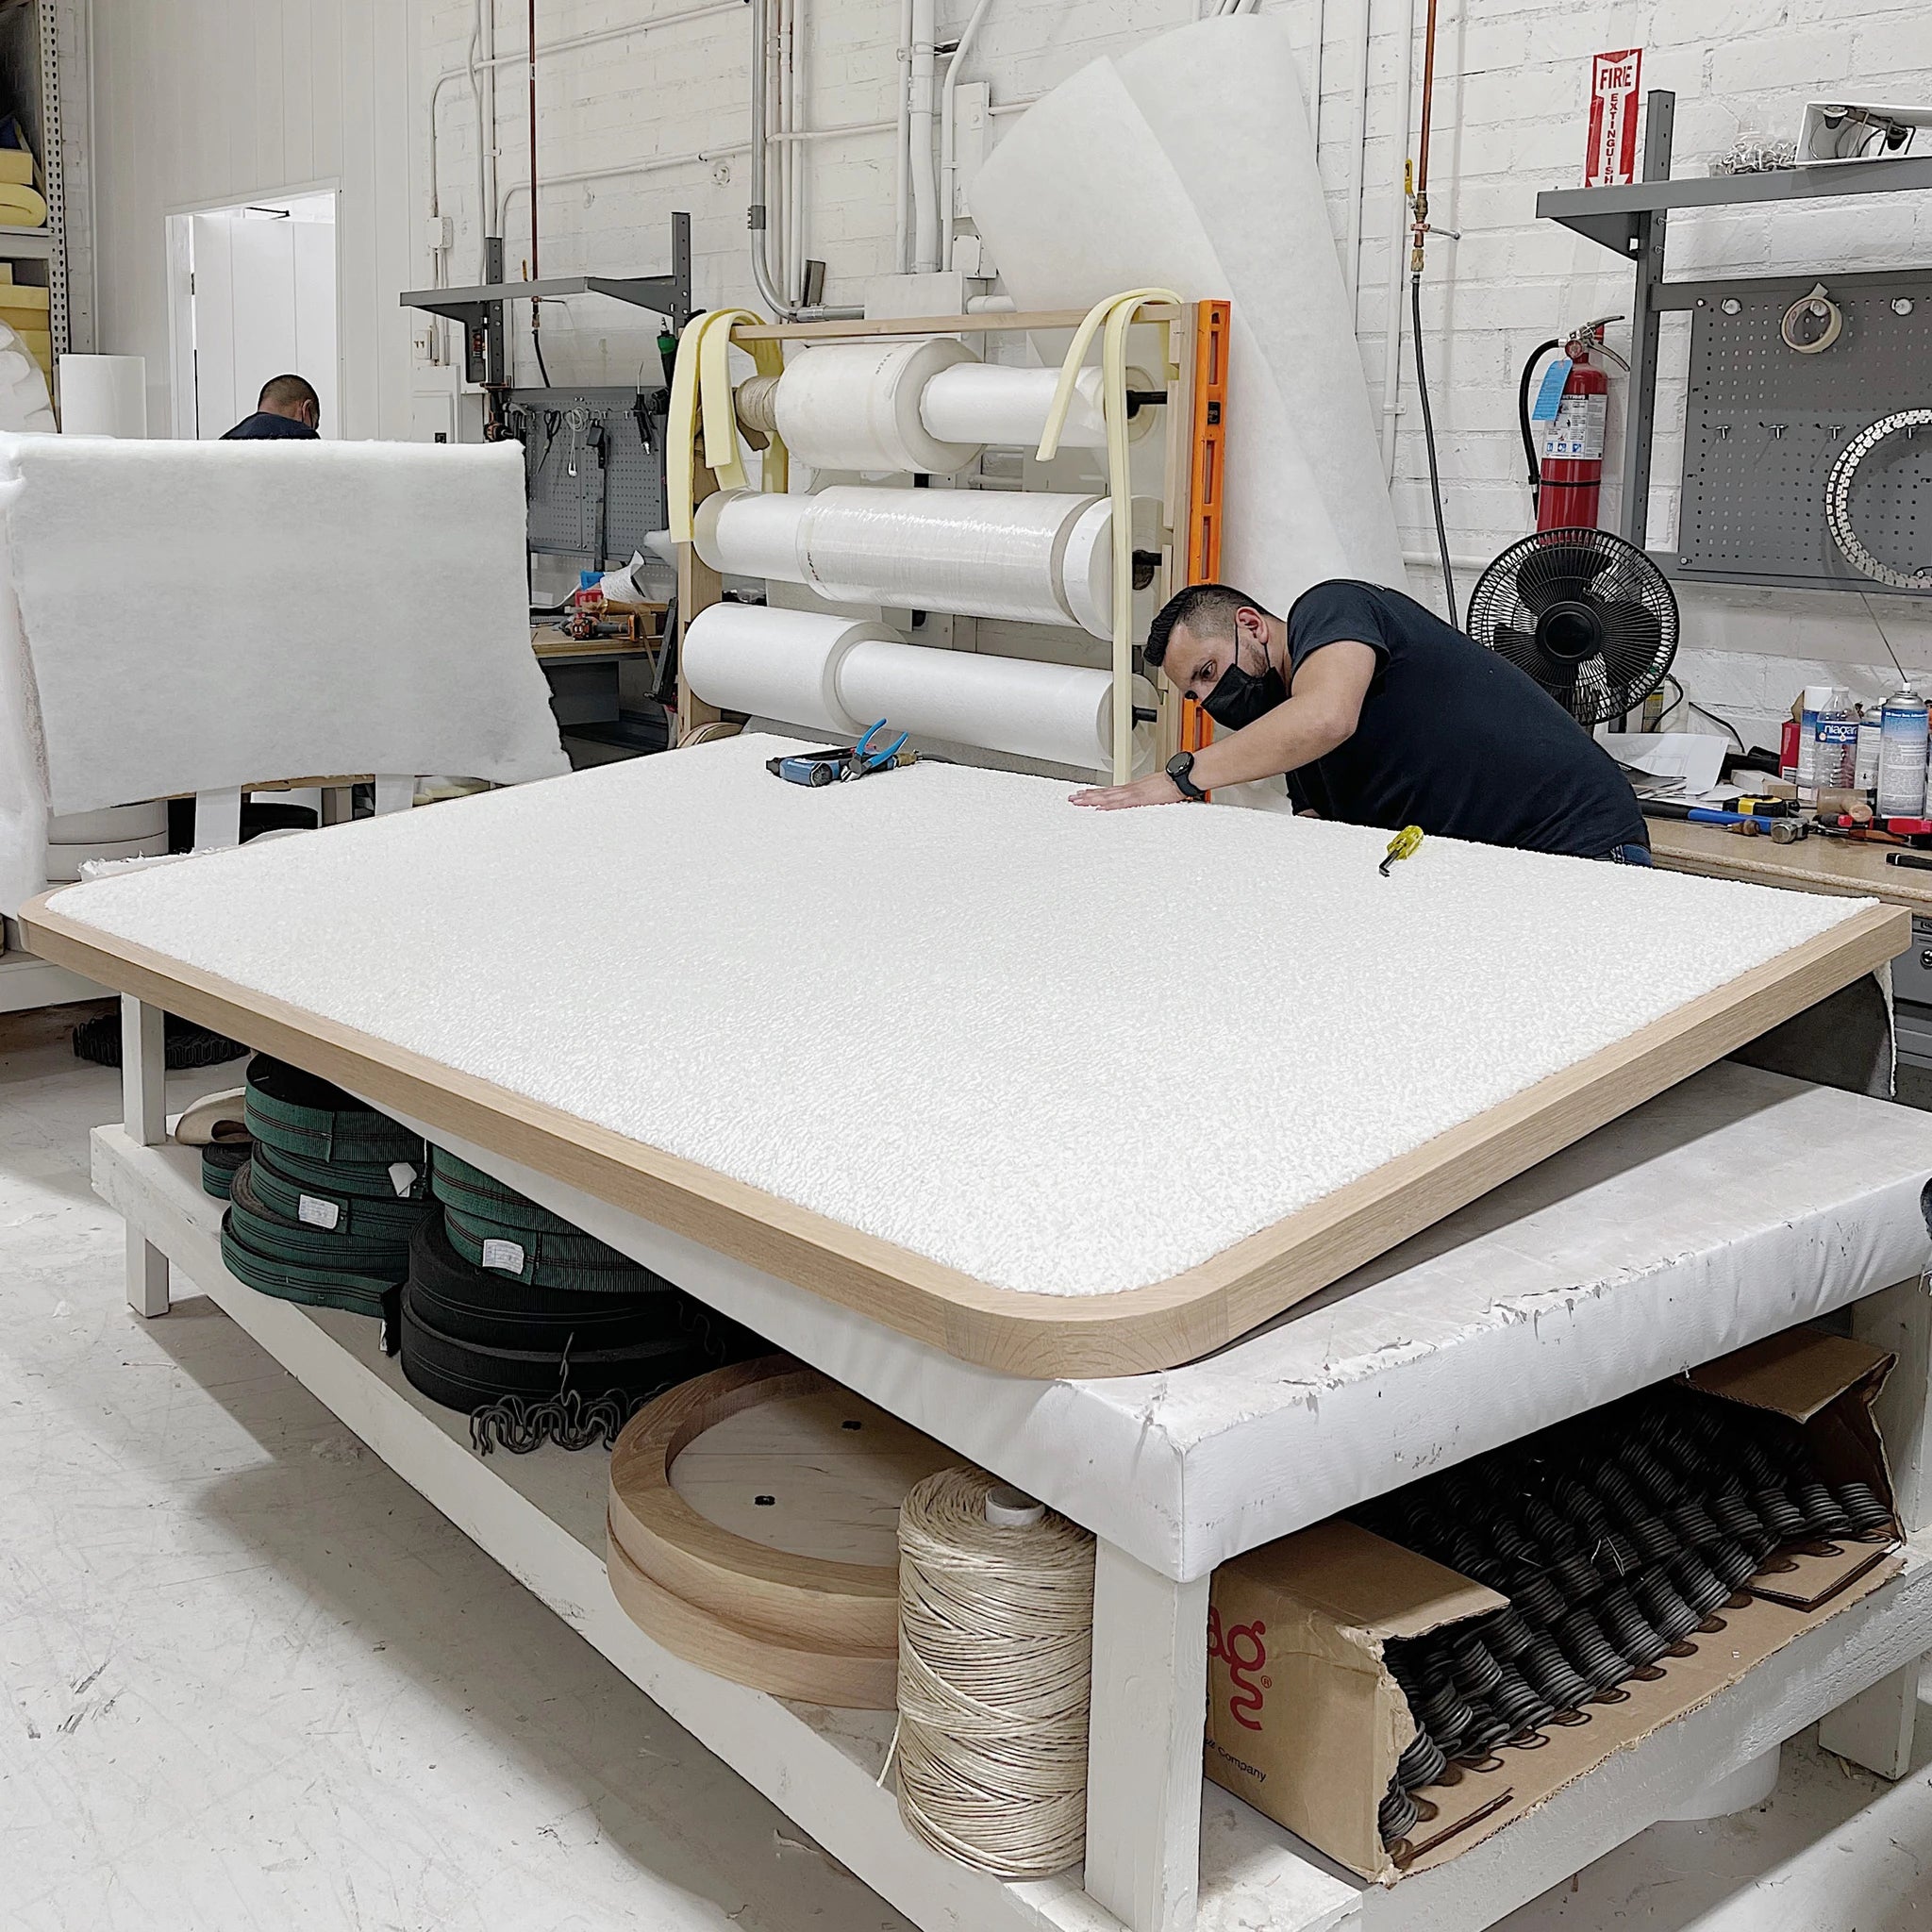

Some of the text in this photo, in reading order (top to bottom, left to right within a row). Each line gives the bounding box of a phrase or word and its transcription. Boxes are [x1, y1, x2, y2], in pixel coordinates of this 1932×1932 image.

[1599, 65, 1633, 91] FIRE
[1604, 92, 1619, 186] EXTINGUISH
[1824, 724, 1857, 741] niagar
[1217, 1746, 1267, 1783] Company
